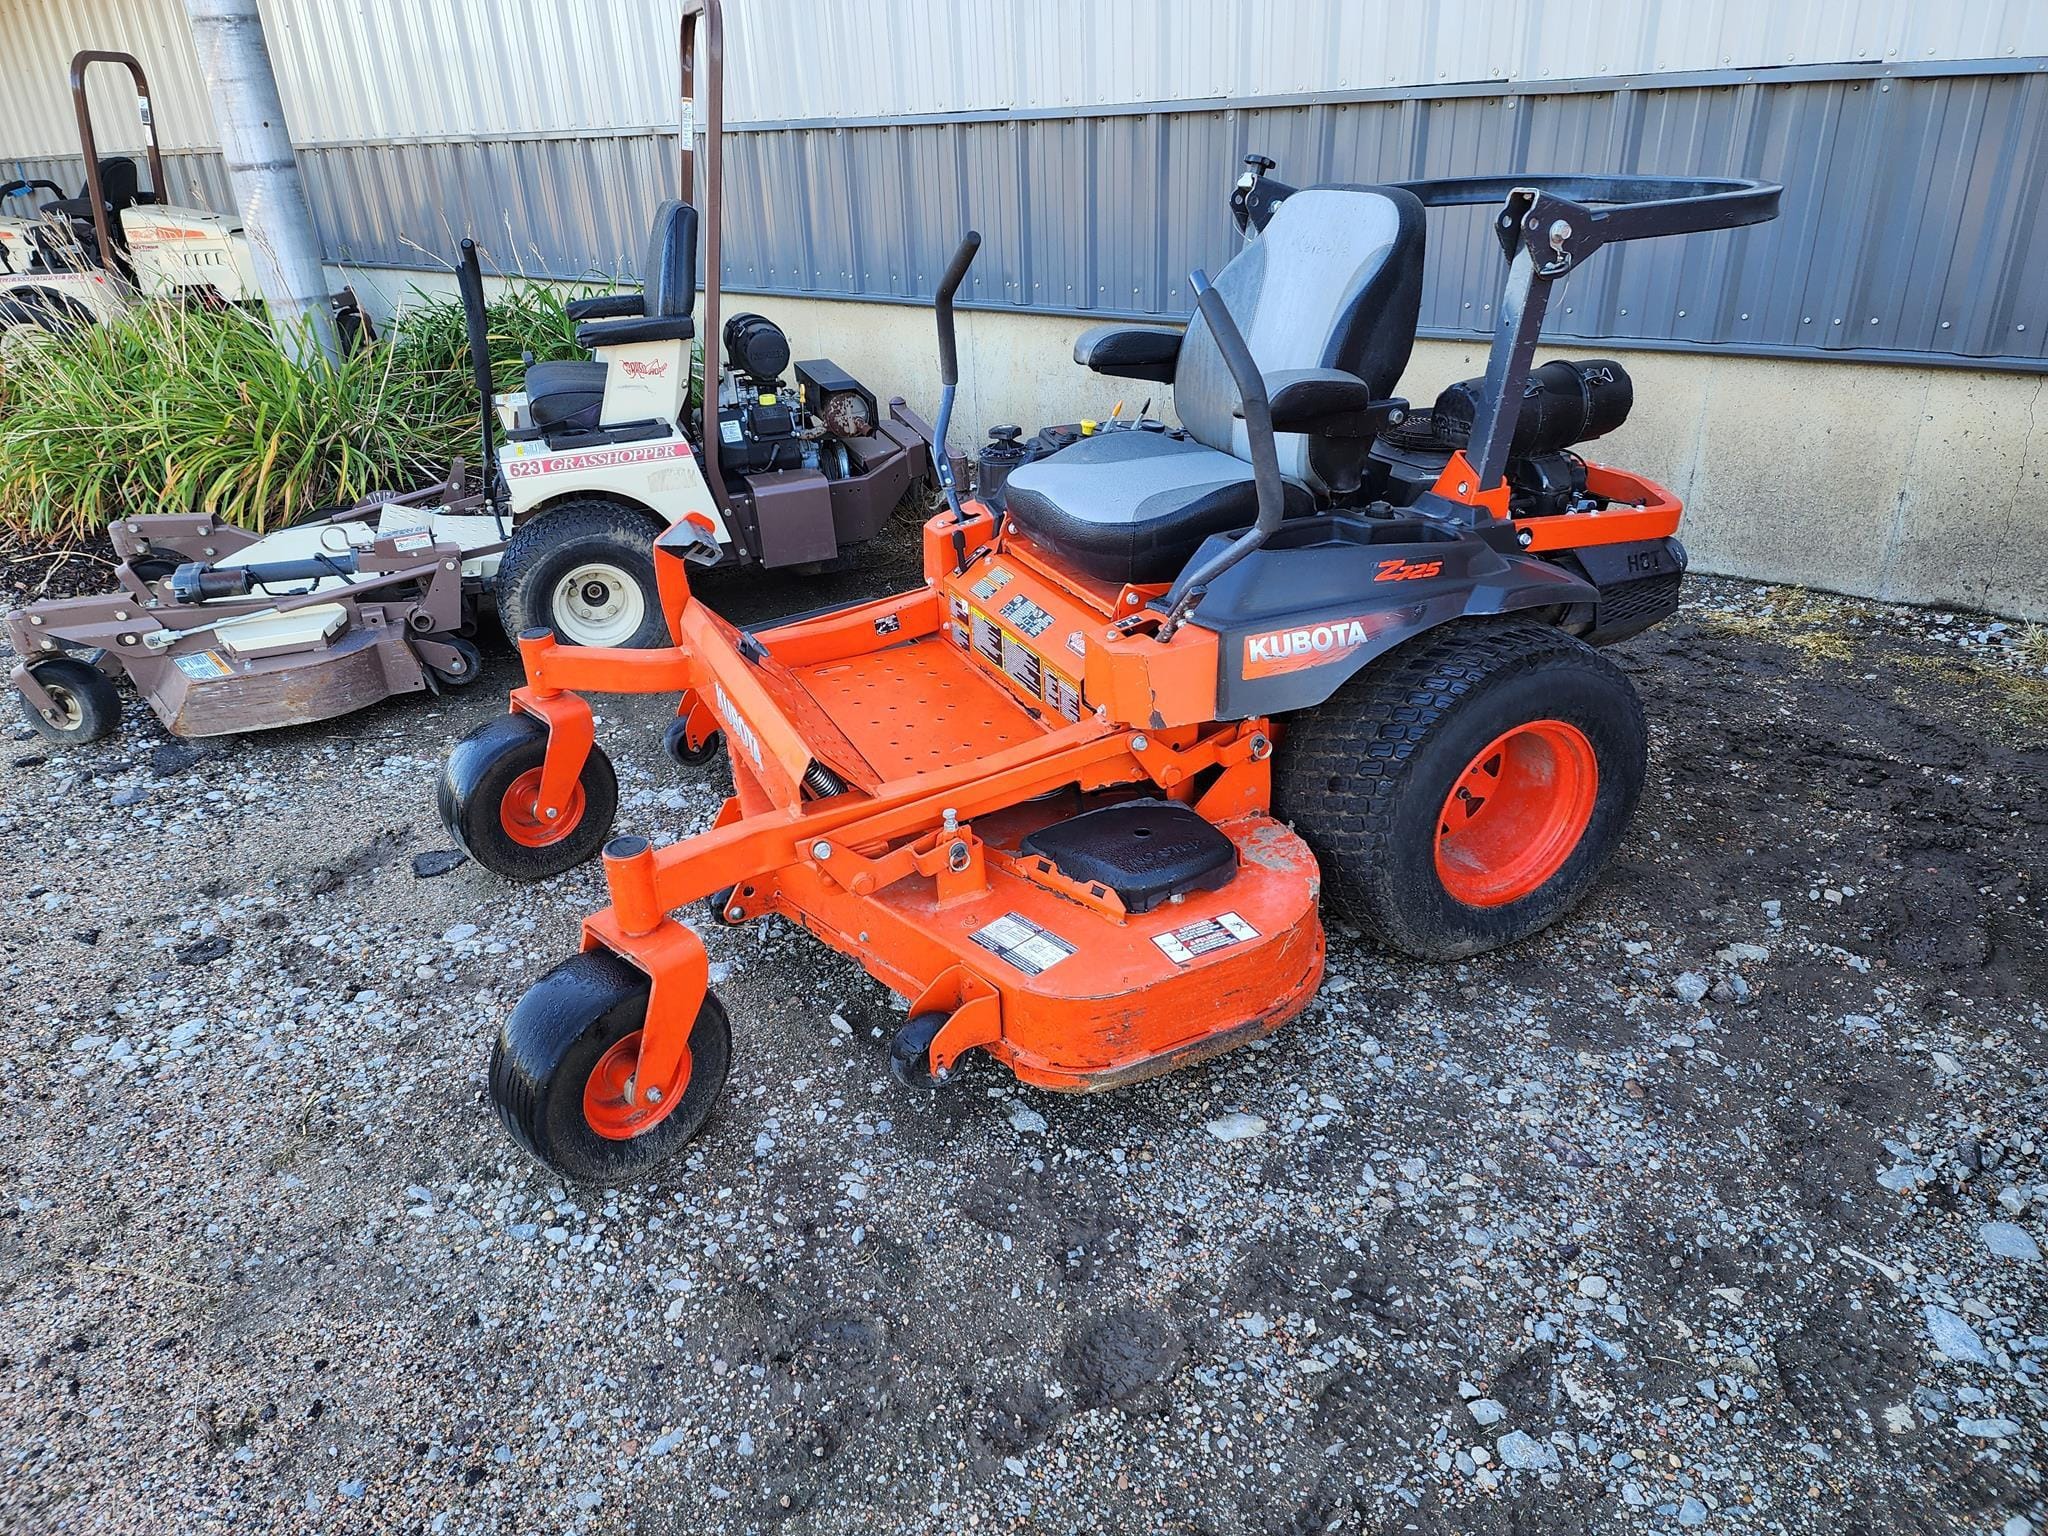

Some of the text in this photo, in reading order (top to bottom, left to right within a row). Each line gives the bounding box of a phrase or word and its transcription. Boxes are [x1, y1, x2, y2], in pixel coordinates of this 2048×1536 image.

[509, 460, 541, 478] 623
[551, 444, 676, 472] GRASSHOPPER
[1627, 550, 1660, 573] HOT
[1249, 621, 1368, 663] KUBOTA
